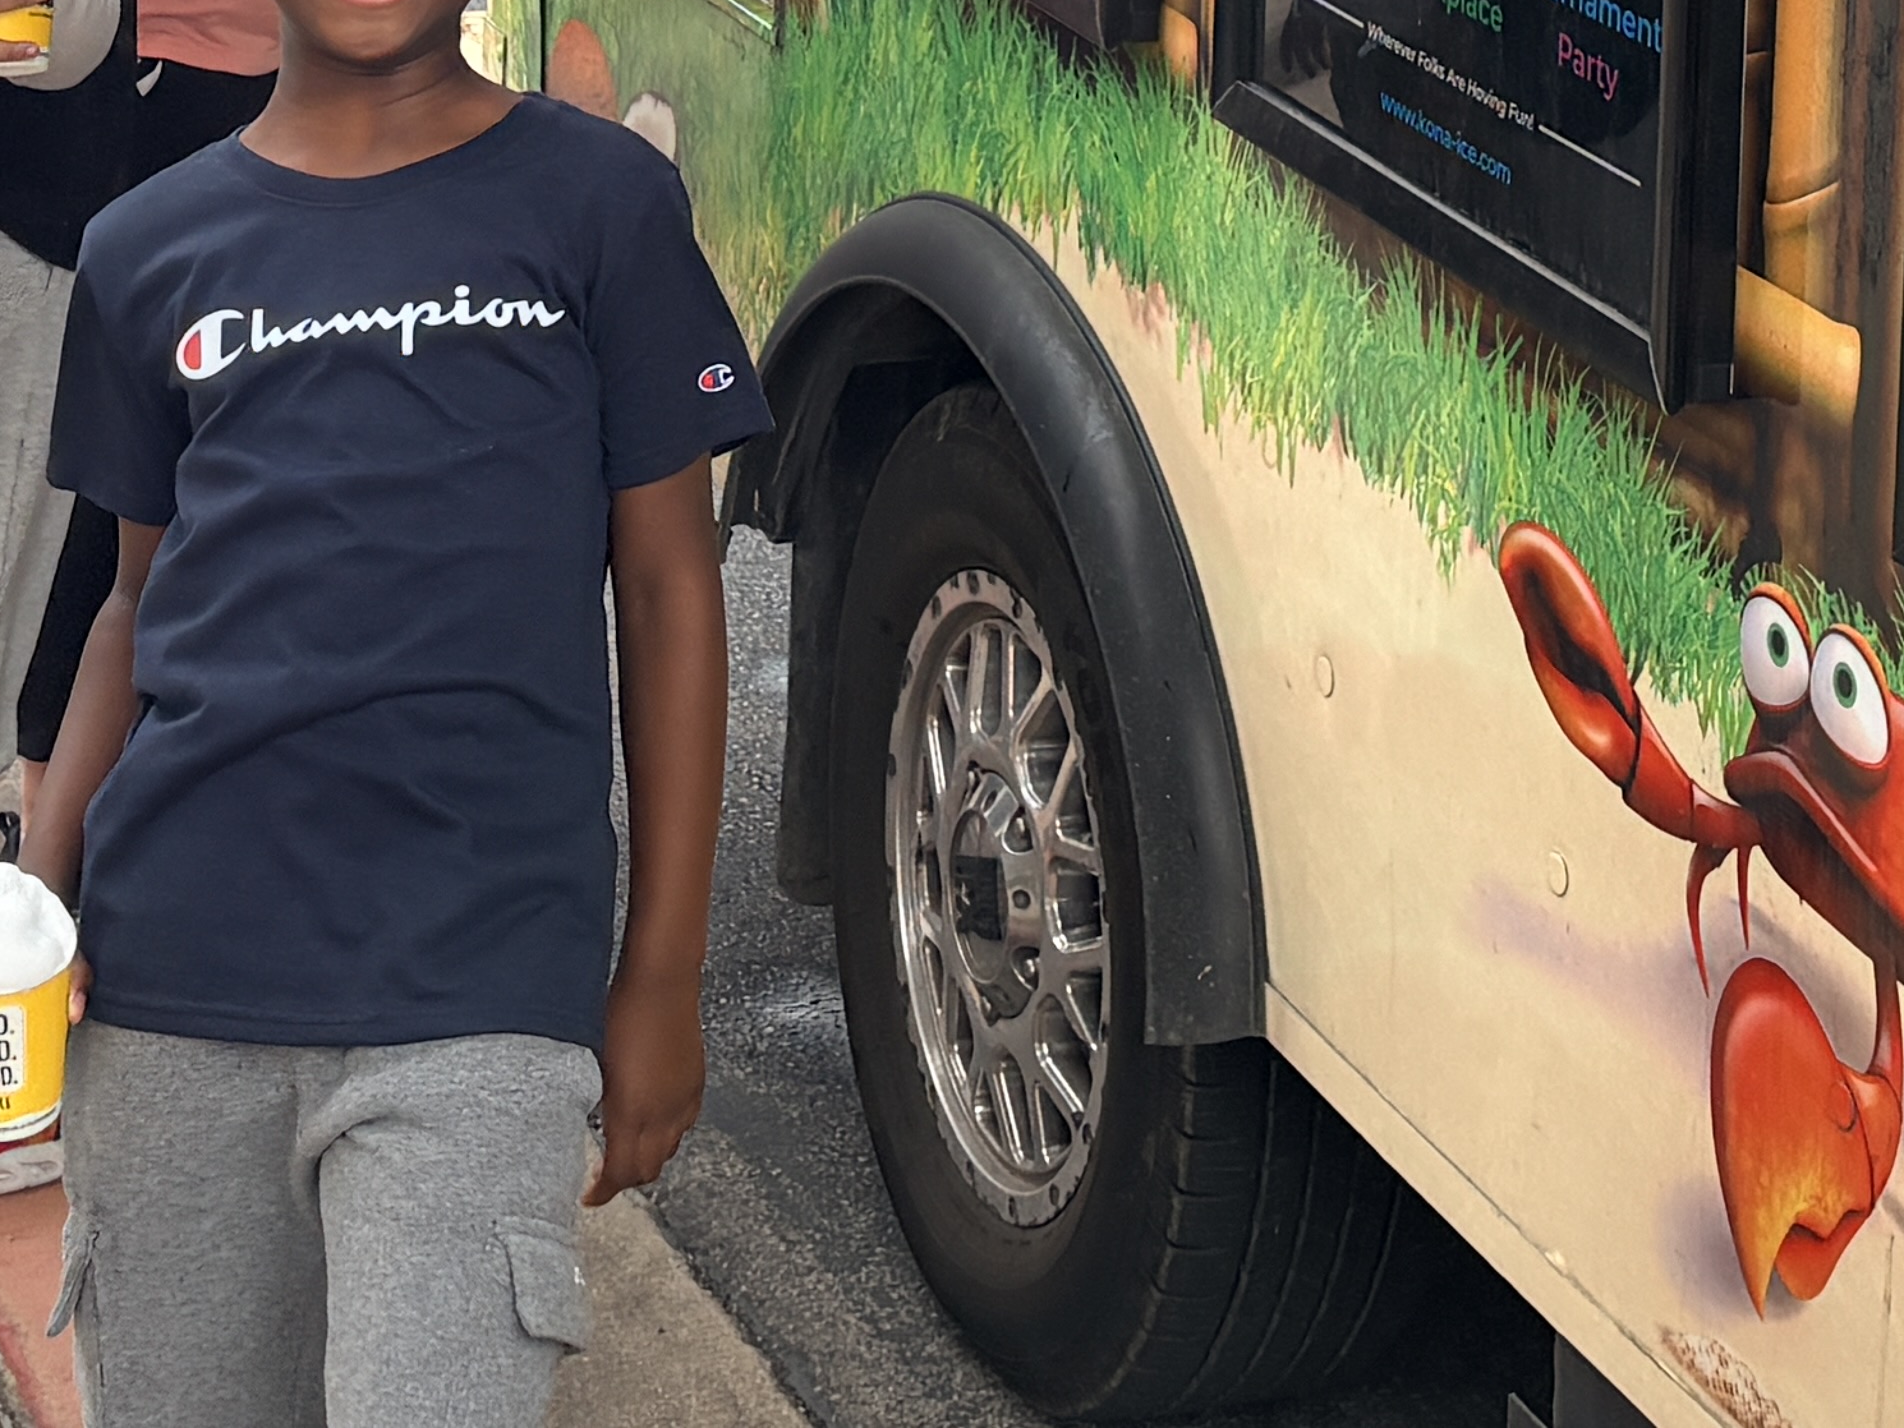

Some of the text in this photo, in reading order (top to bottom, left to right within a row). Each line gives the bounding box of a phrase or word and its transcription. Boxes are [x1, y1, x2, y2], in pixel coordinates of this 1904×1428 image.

[1367, 20, 1535, 131] Wherever Folks Are Having Fun!
[1558, 31, 1619, 102] Party
[1380, 91, 1511, 185] www.kona-ice.com
[175, 284, 565, 380] Champion
